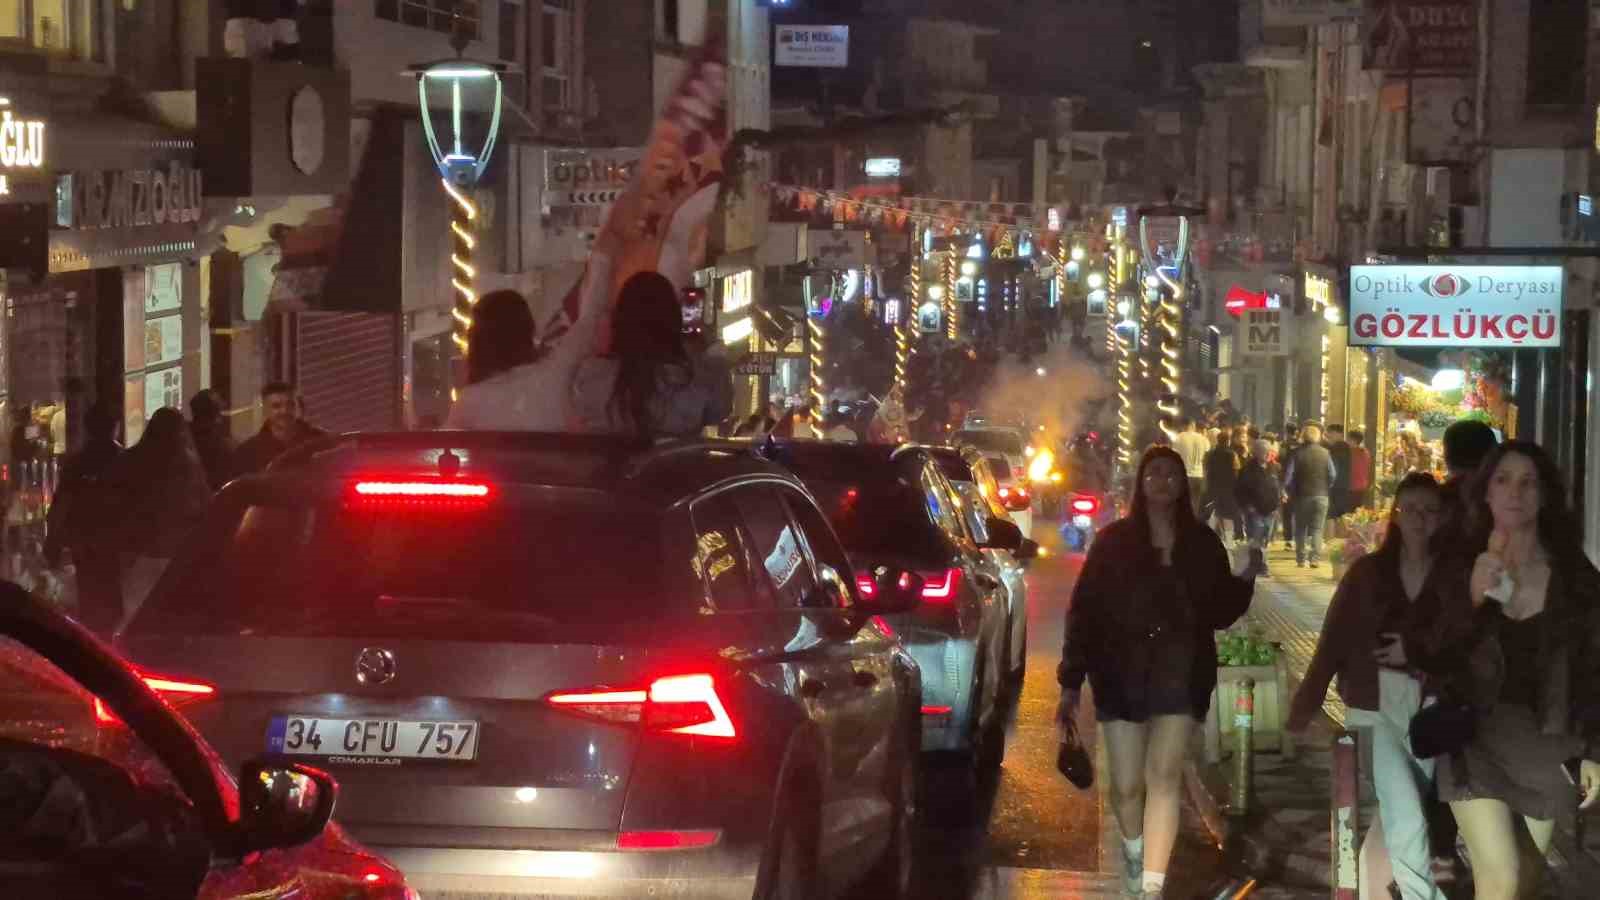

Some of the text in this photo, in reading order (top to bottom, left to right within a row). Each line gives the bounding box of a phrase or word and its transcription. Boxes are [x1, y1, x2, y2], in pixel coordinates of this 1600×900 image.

[1355, 274, 1414, 300] Optik
[1478, 274, 1556, 300] Deryası
[1354, 307, 1556, 344] GÖZLÜKÇÜ
[286, 719, 474, 755] 34 CFU 757
